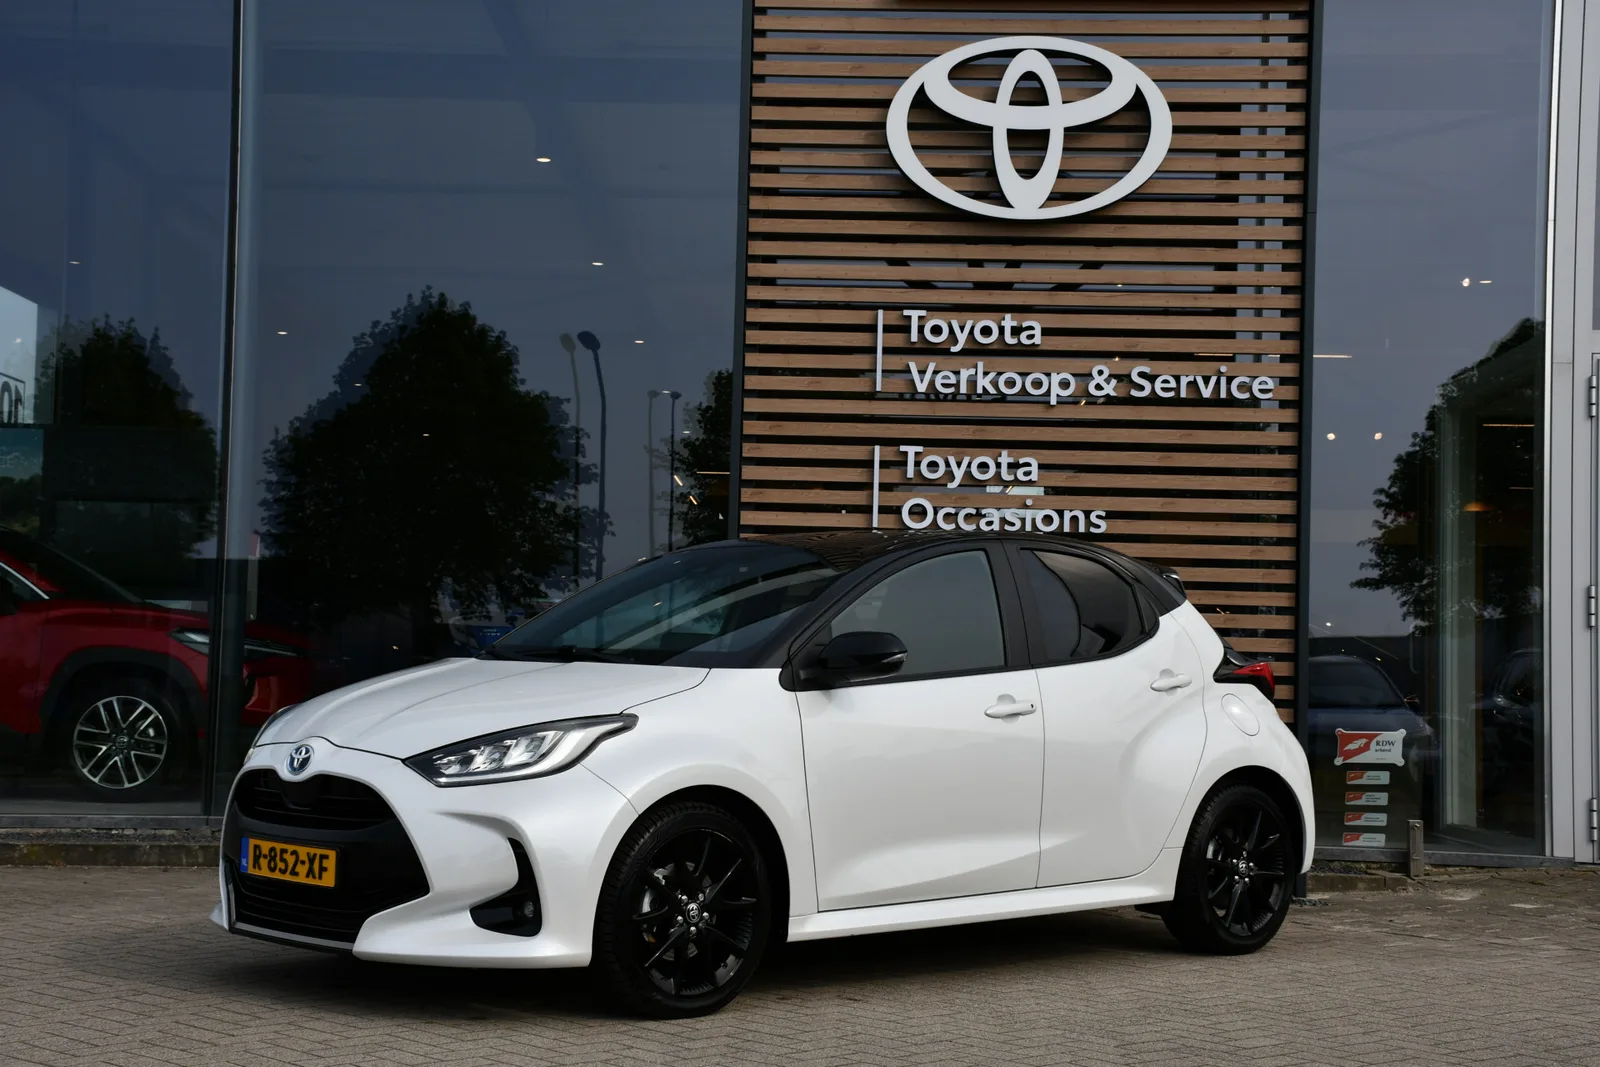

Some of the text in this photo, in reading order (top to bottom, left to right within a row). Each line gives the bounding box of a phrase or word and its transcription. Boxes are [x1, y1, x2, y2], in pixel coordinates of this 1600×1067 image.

[903, 309, 1042, 353] Toyota
[908, 361, 1275, 406] Verkoop & Service
[899, 445, 1039, 489] Toyota
[901, 497, 1108, 534] Occasions
[252, 844, 330, 881] R-852-XF
